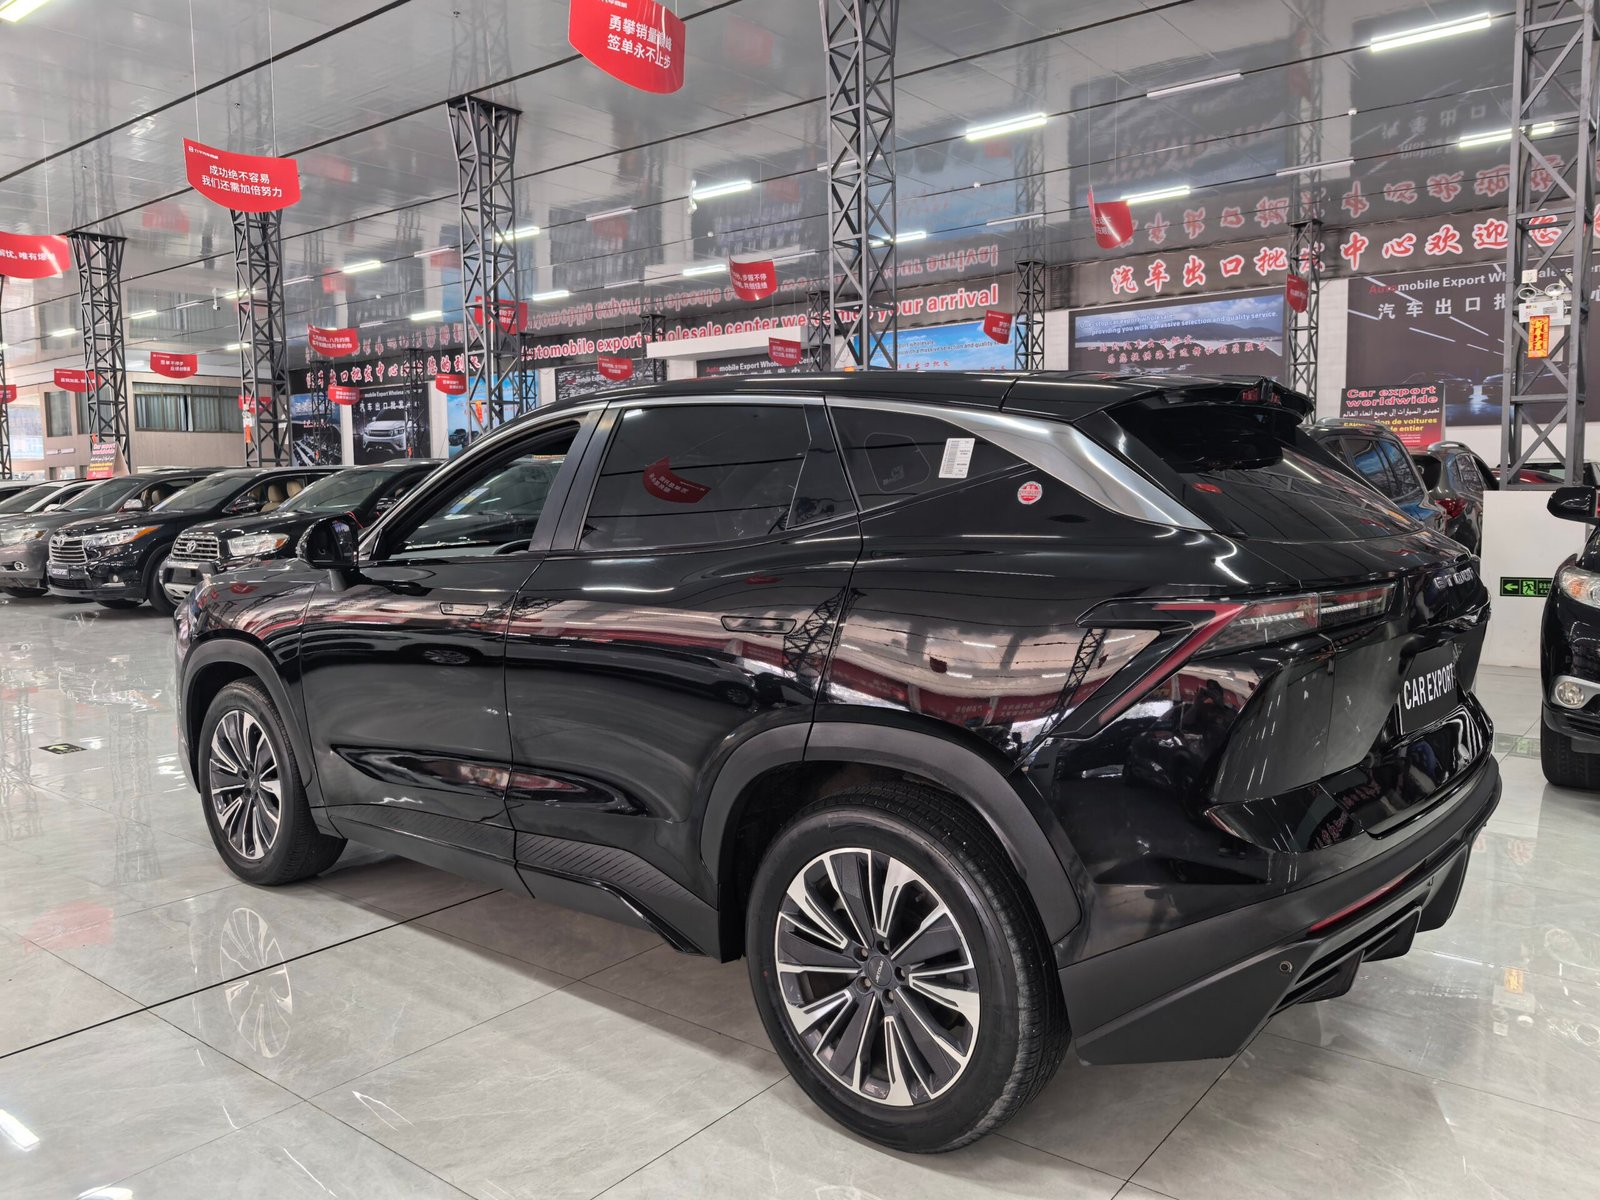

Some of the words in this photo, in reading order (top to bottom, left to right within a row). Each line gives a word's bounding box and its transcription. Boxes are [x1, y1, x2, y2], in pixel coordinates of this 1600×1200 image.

[607, 33, 671, 69] 签单永不止步
[209, 165, 270, 184] 成功绝不容易
[201, 175, 283, 198] 我们还需加倍努力
[1443, 274, 1486, 289] Export
[597, 332, 643, 354] export
[725, 316, 779, 336] center
[927, 283, 999, 312] arrival
[1091, 325, 1121, 335] providing
[1121, 326, 1134, 334] you
[1154, 321, 1180, 329] massive
[1181, 318, 1212, 327] selection
[1225, 314, 1250, 324] quality
[1251, 311, 1278, 320] service.
[740, 362, 760, 370] Export
[1347, 389, 1376, 399] Car
[1379, 386, 1437, 397] export
[1346, 395, 1439, 408] worldwide
[1342, 410, 1358, 418] العالم
[1373, 410, 1388, 419] جميع
[1403, 417, 1438, 425] voitures
[1404, 676, 1427, 710] CAR
[1427, 663, 1456, 701] EXPORT
